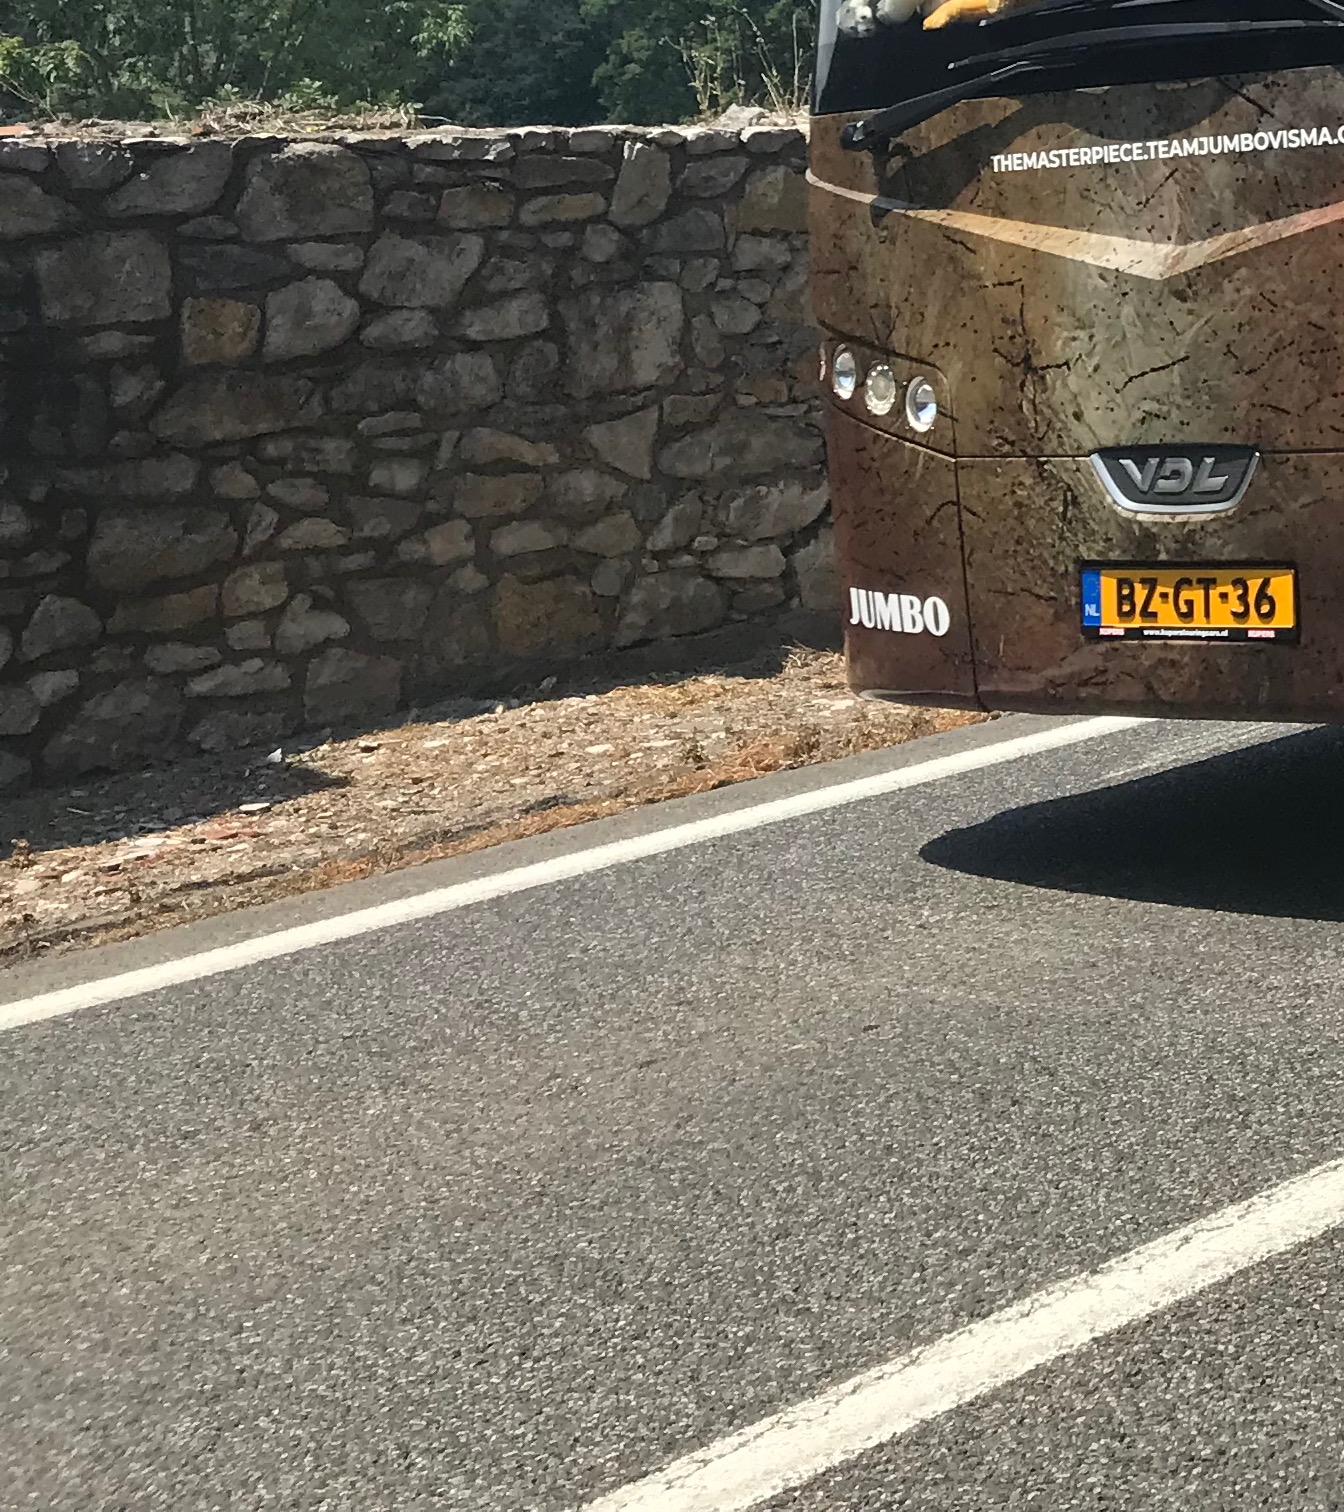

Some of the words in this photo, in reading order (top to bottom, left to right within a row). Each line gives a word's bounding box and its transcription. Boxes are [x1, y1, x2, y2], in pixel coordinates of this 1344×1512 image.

[1118, 456, 1229, 493] VDL
[849, 587, 951, 637] JUMBO
[1085, 603, 1100, 617] NL
[1115, 577, 1276, 620] BZ-GT-36
